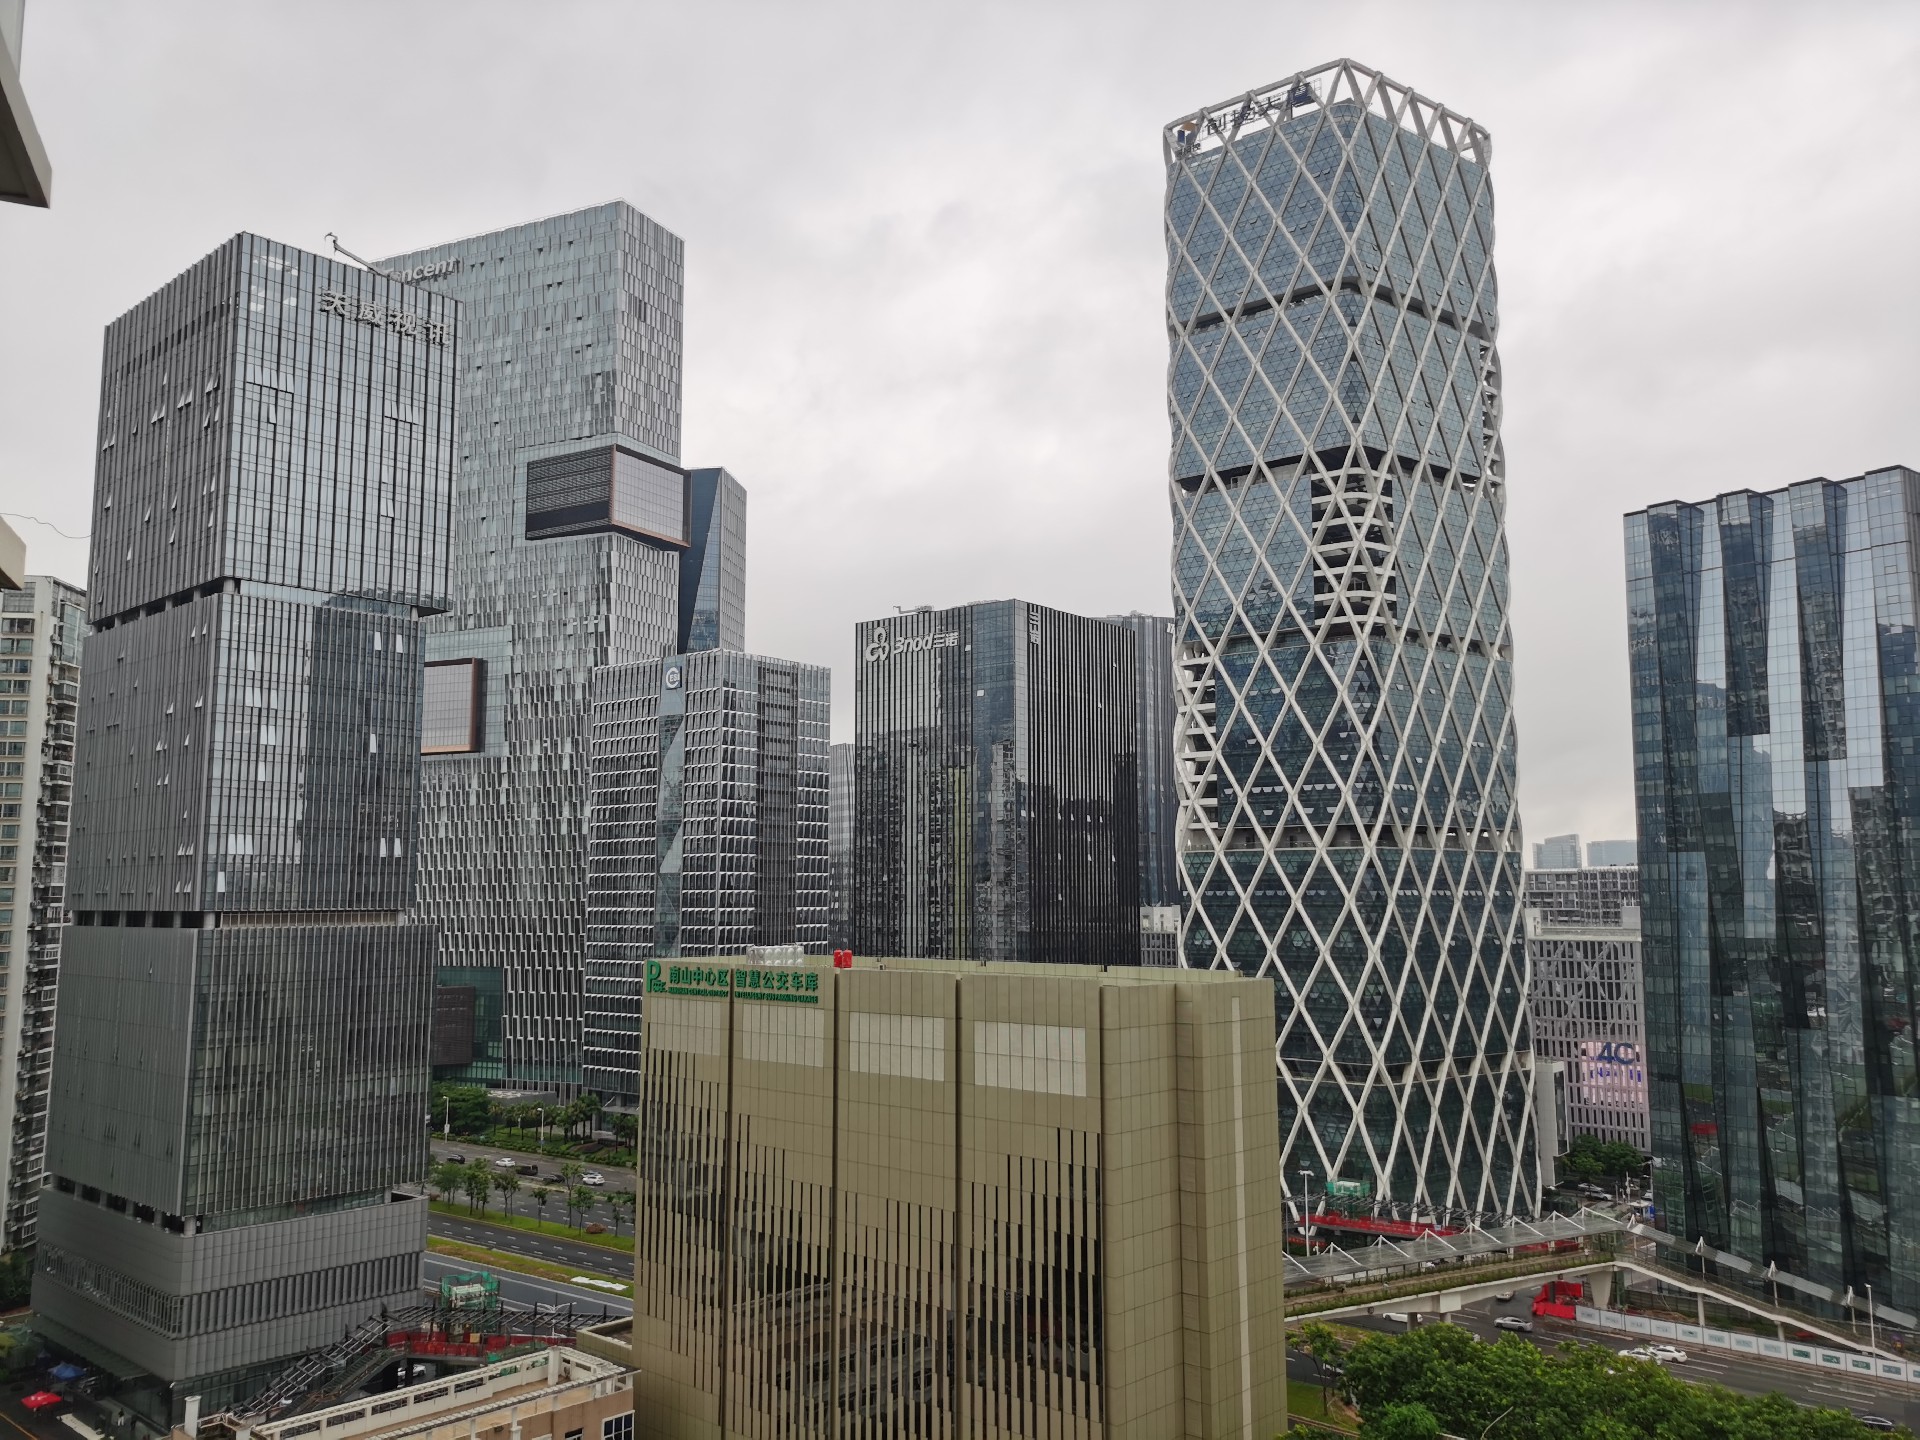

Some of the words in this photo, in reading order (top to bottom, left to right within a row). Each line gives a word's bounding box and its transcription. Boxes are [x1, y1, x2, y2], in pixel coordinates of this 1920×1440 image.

[321, 290, 450, 345] 天威视讯
[893, 632, 934, 655] 3nod
[669, 965, 729, 987] 南山中心区
[735, 968, 819, 992] 智慧公交车库
